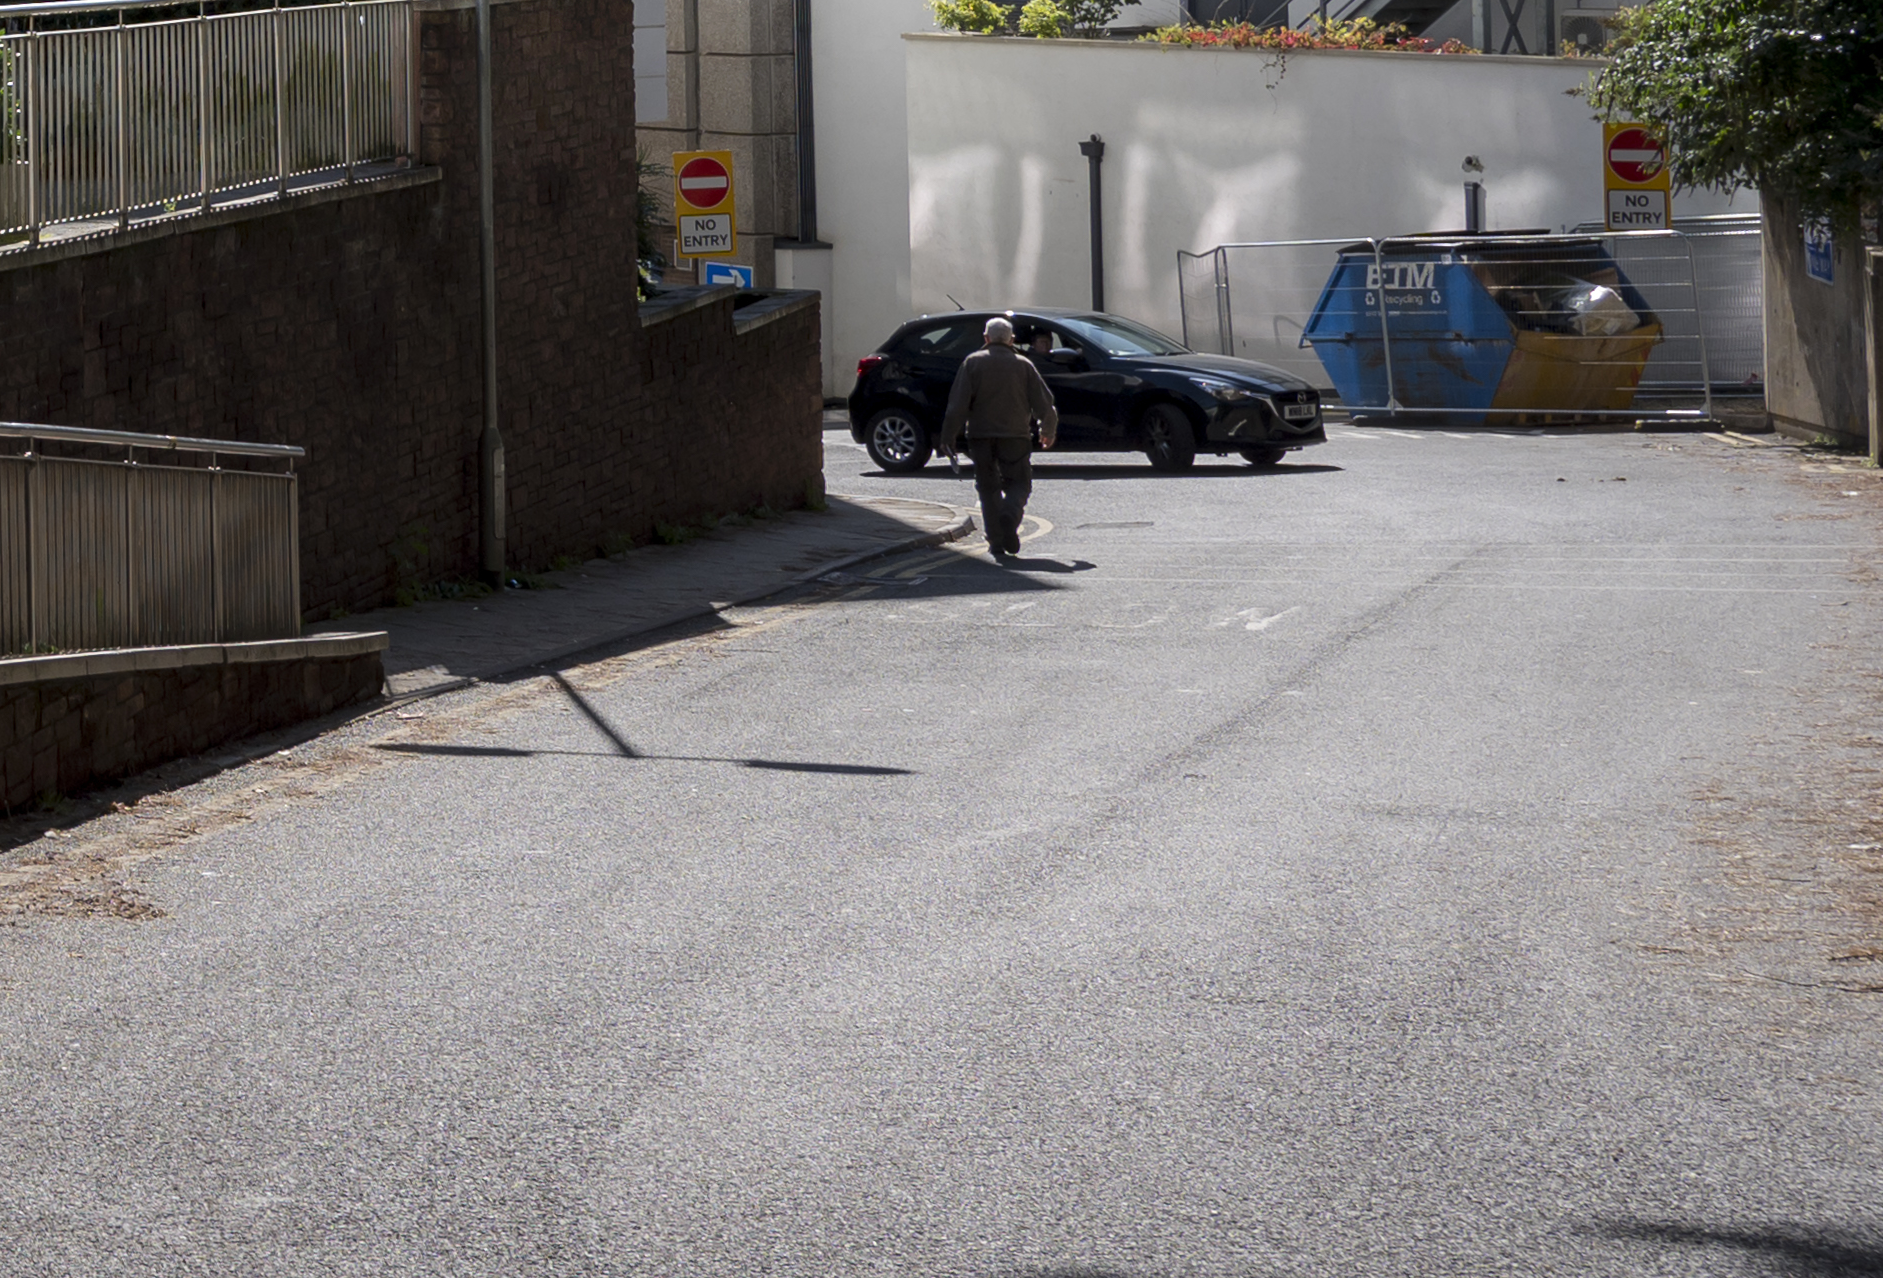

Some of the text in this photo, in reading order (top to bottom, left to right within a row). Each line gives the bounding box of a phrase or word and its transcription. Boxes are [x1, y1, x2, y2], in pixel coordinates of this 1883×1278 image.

[1625, 195, 1649, 207] NO
[1612, 211, 1662, 224] ENTRY
[695, 219, 716, 231] NO
[684, 234, 728, 247] ENTRY
